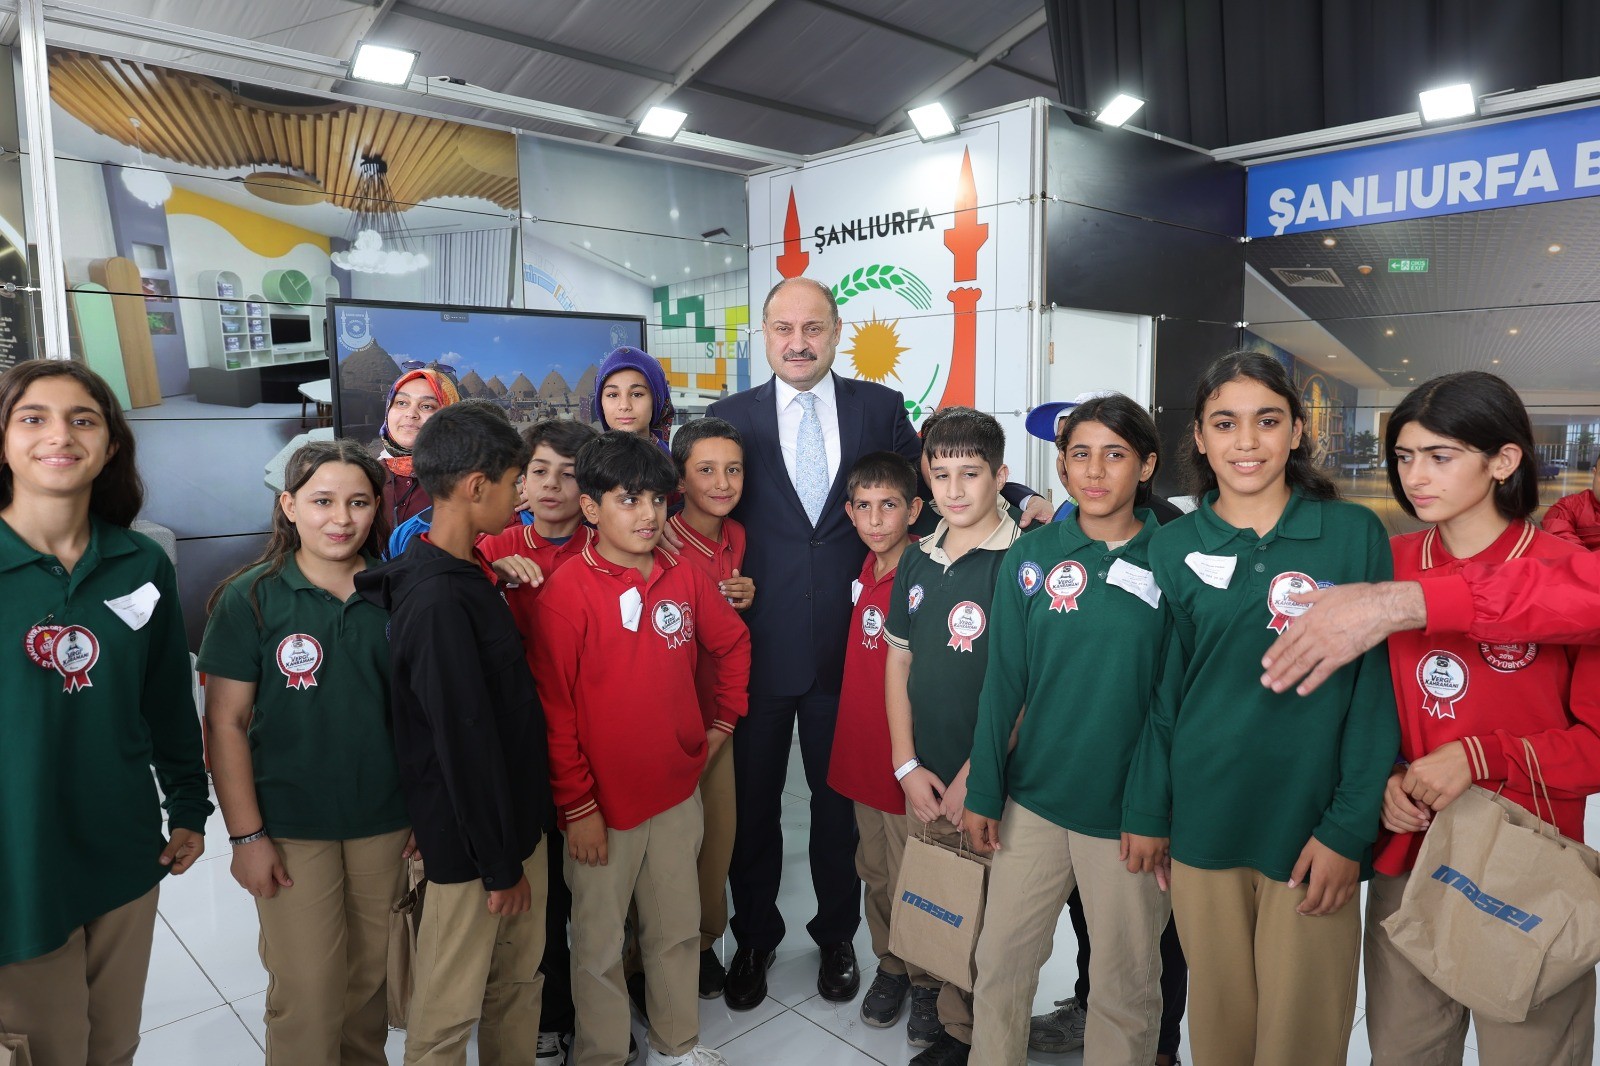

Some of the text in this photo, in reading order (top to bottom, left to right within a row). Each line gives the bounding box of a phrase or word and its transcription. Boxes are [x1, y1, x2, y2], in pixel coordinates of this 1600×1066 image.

[1267, 148, 1559, 236] ŞANLIURFA
[814, 206, 935, 254] ŞANLIURFA
[706, 341, 749, 359] STEM
